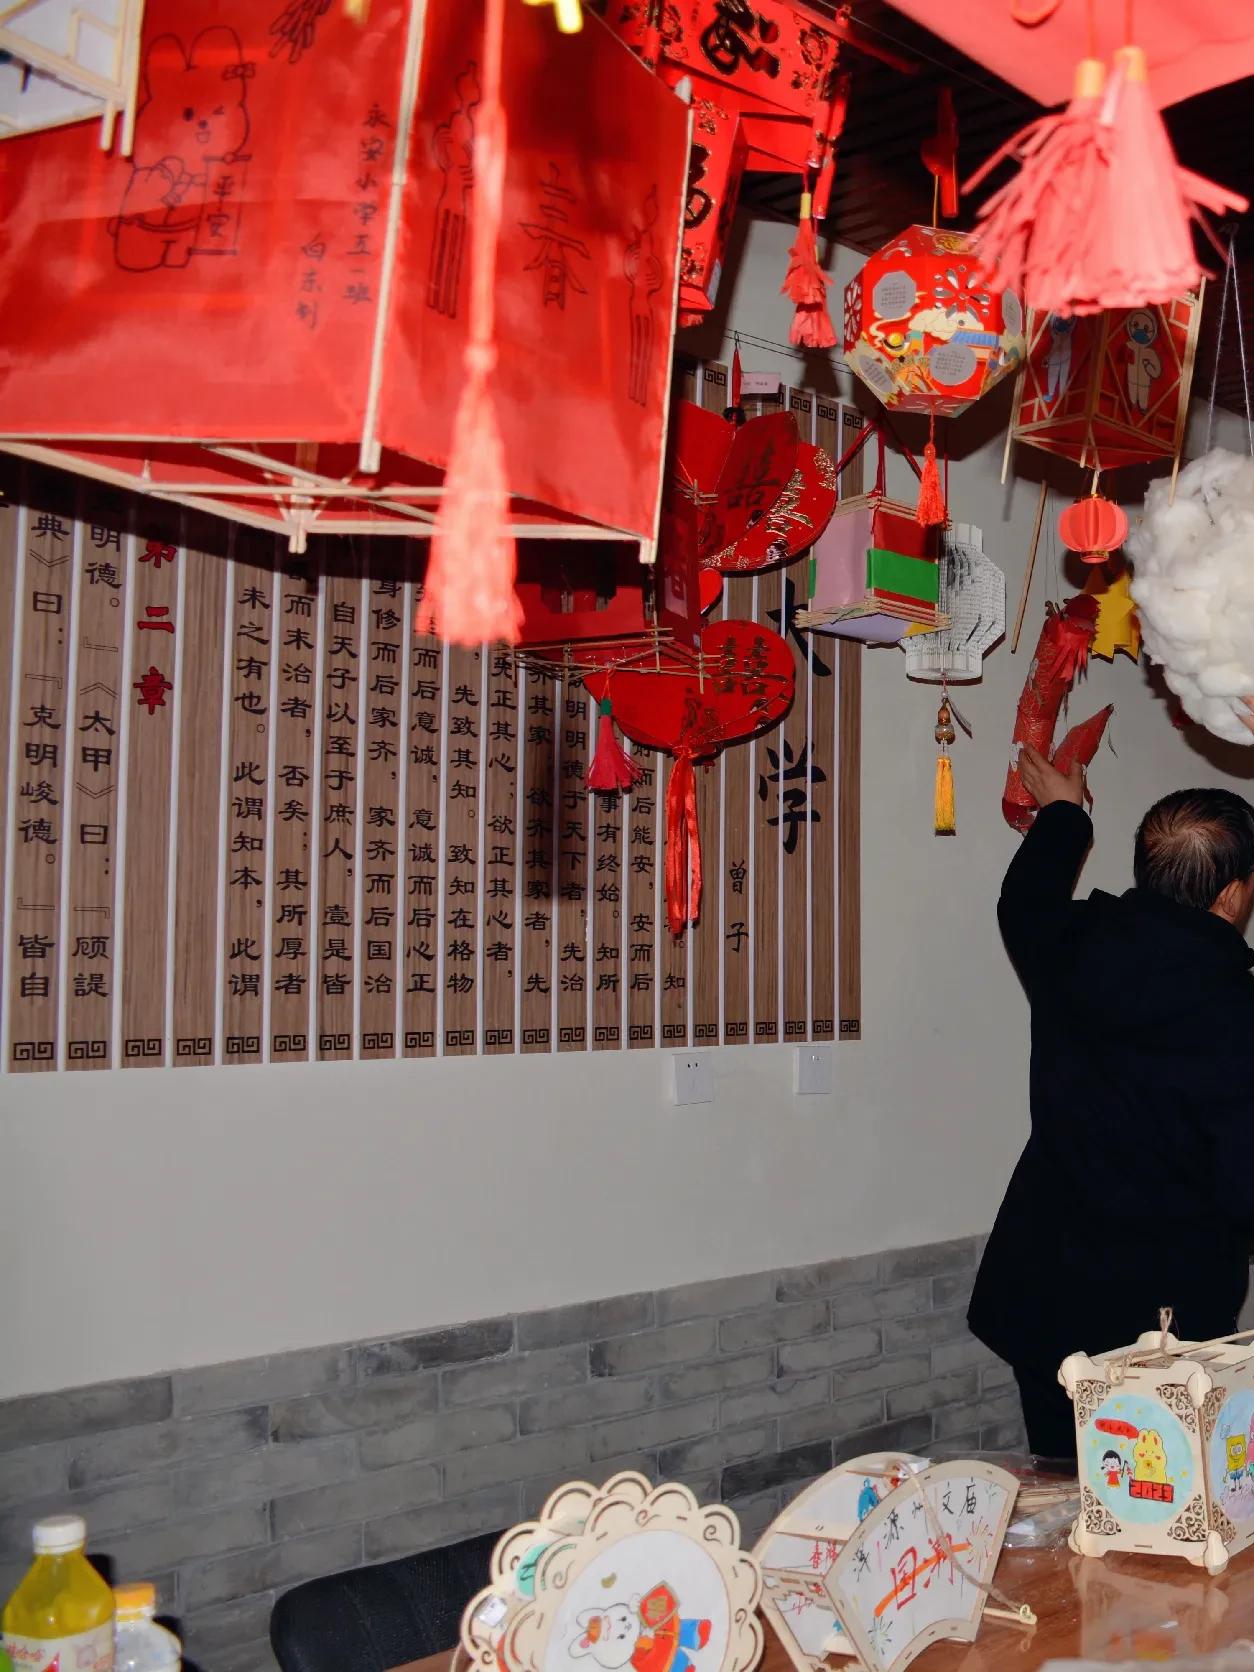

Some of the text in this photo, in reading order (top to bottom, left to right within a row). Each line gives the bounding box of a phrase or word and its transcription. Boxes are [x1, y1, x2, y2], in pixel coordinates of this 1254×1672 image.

[406, 585, 442, 994] 而后意诚，意诚而后心正
[758, 578, 832, 855] 大学
[726, 860, 750, 954] 曾子
